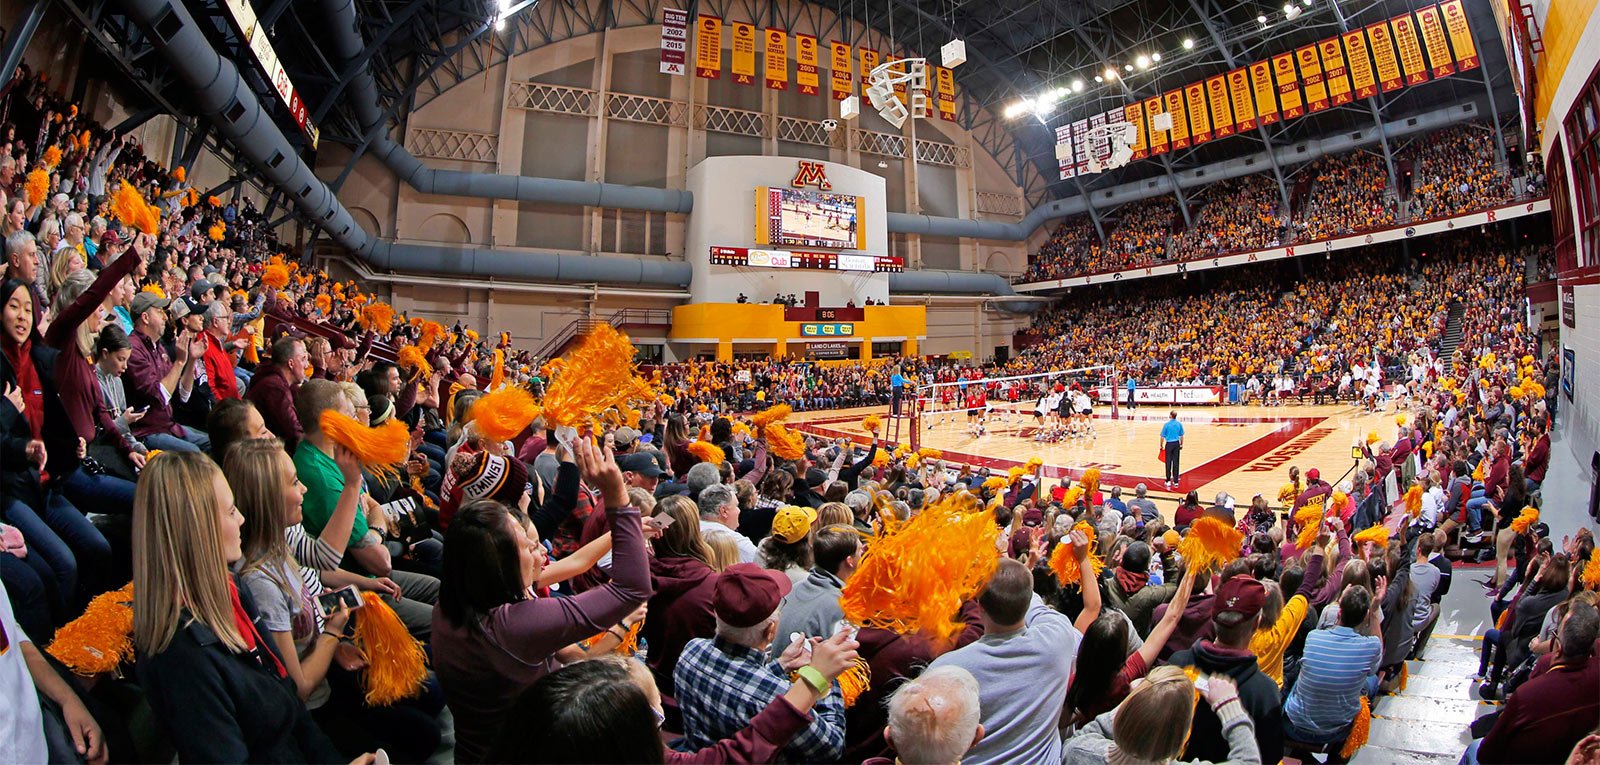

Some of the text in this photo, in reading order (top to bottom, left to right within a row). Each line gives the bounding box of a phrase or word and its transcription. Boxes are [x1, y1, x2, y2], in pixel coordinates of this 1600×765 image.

[667, 28, 683, 36] 2002
[666, 41, 682, 49] 2015
[1328, 68, 1343, 78] 2007
[1306, 76, 1320, 85] 2002
[1281, 84, 1295, 93] 2001
[791, 160, 832, 191] M
[1486, 210, 1497, 222] R
[1285, 246, 1296, 257] N
[771, 257, 787, 266] Cub
[1176, 262, 1188, 273] M
[1183, 390, 1194, 399] tcf
[1240, 427, 1338, 473] MINNESOTA
[467, 459, 502, 497] FEMINIST
